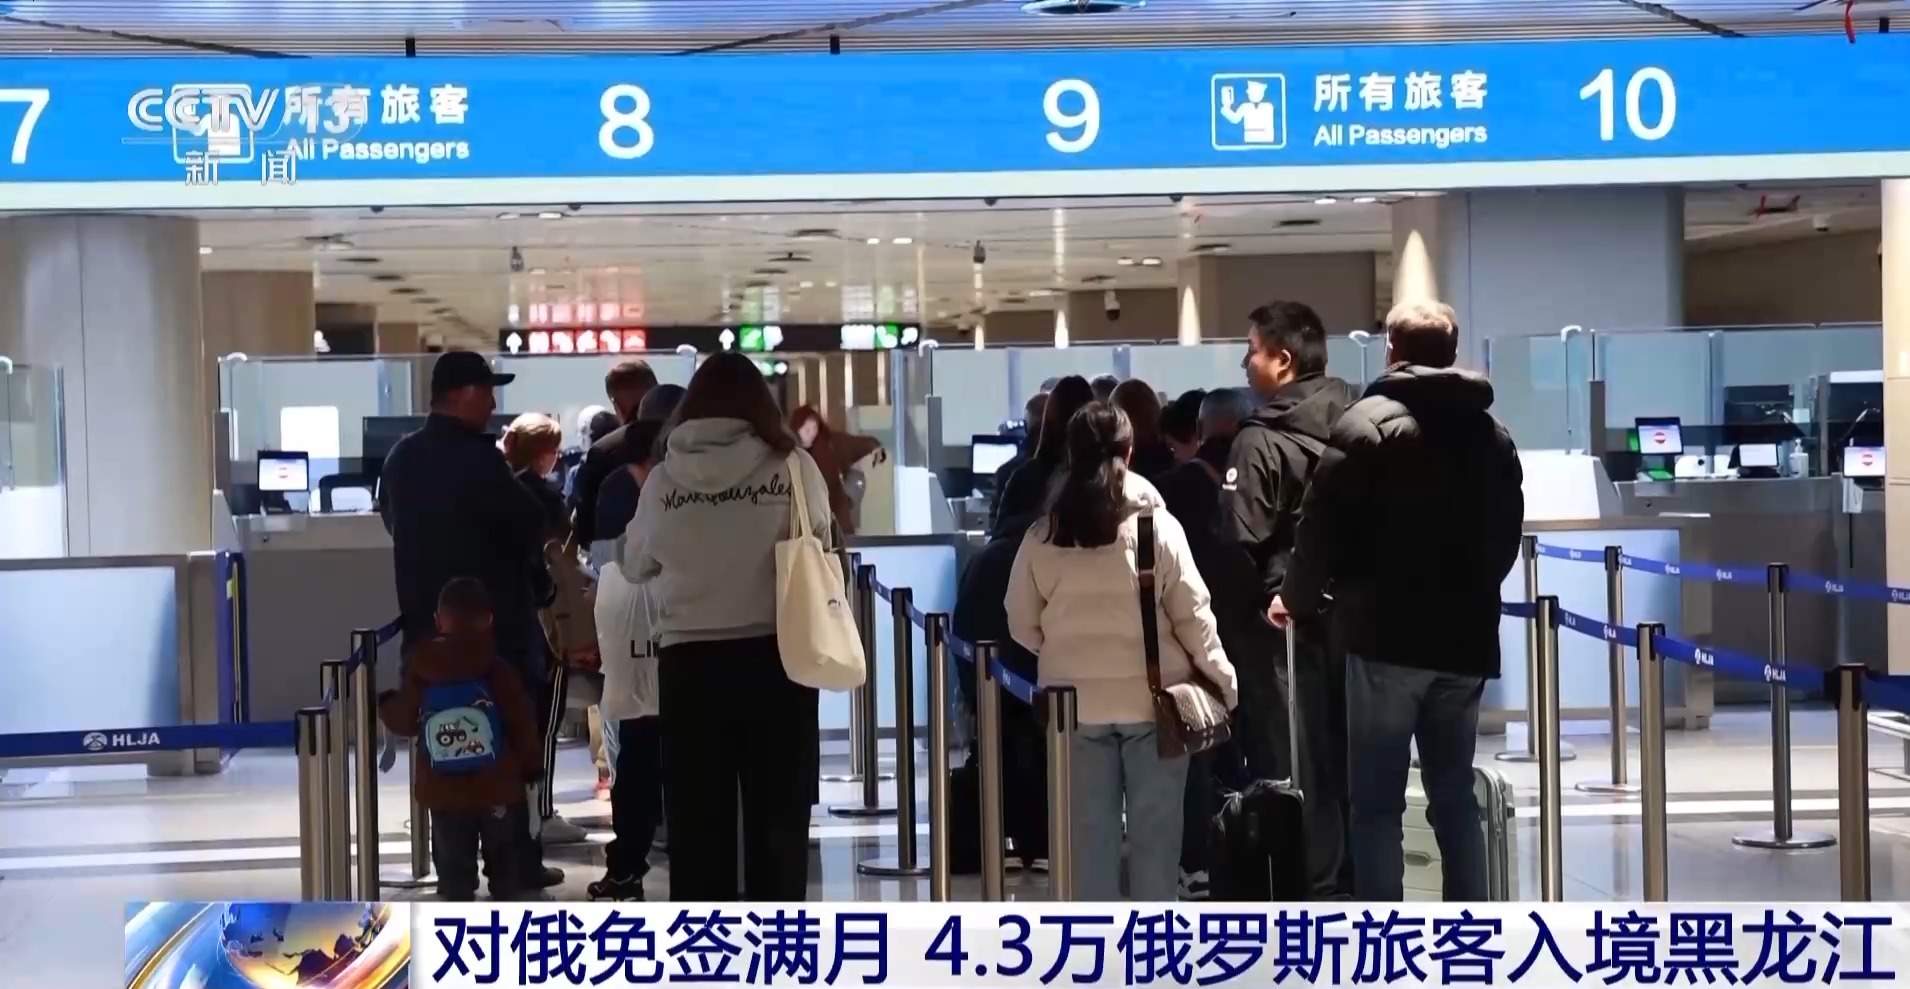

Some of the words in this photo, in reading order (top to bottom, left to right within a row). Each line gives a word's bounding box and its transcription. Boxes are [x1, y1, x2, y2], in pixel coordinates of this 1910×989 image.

[284, 84, 469, 125] 所有旅客
[1313, 70, 1488, 112] 所有旅客
[1579, 67, 1676, 141] 10
[0, 88, 50, 164] 7
[598, 84, 654, 159] 8
[1042, 79, 1100, 153] 9
[1313, 126, 1343, 147] All
[1349, 124, 1488, 149] Passengers
[288, 137, 315, 160] All
[323, 138, 470, 164] Passengers
[112, 732, 160, 747] HLJA
